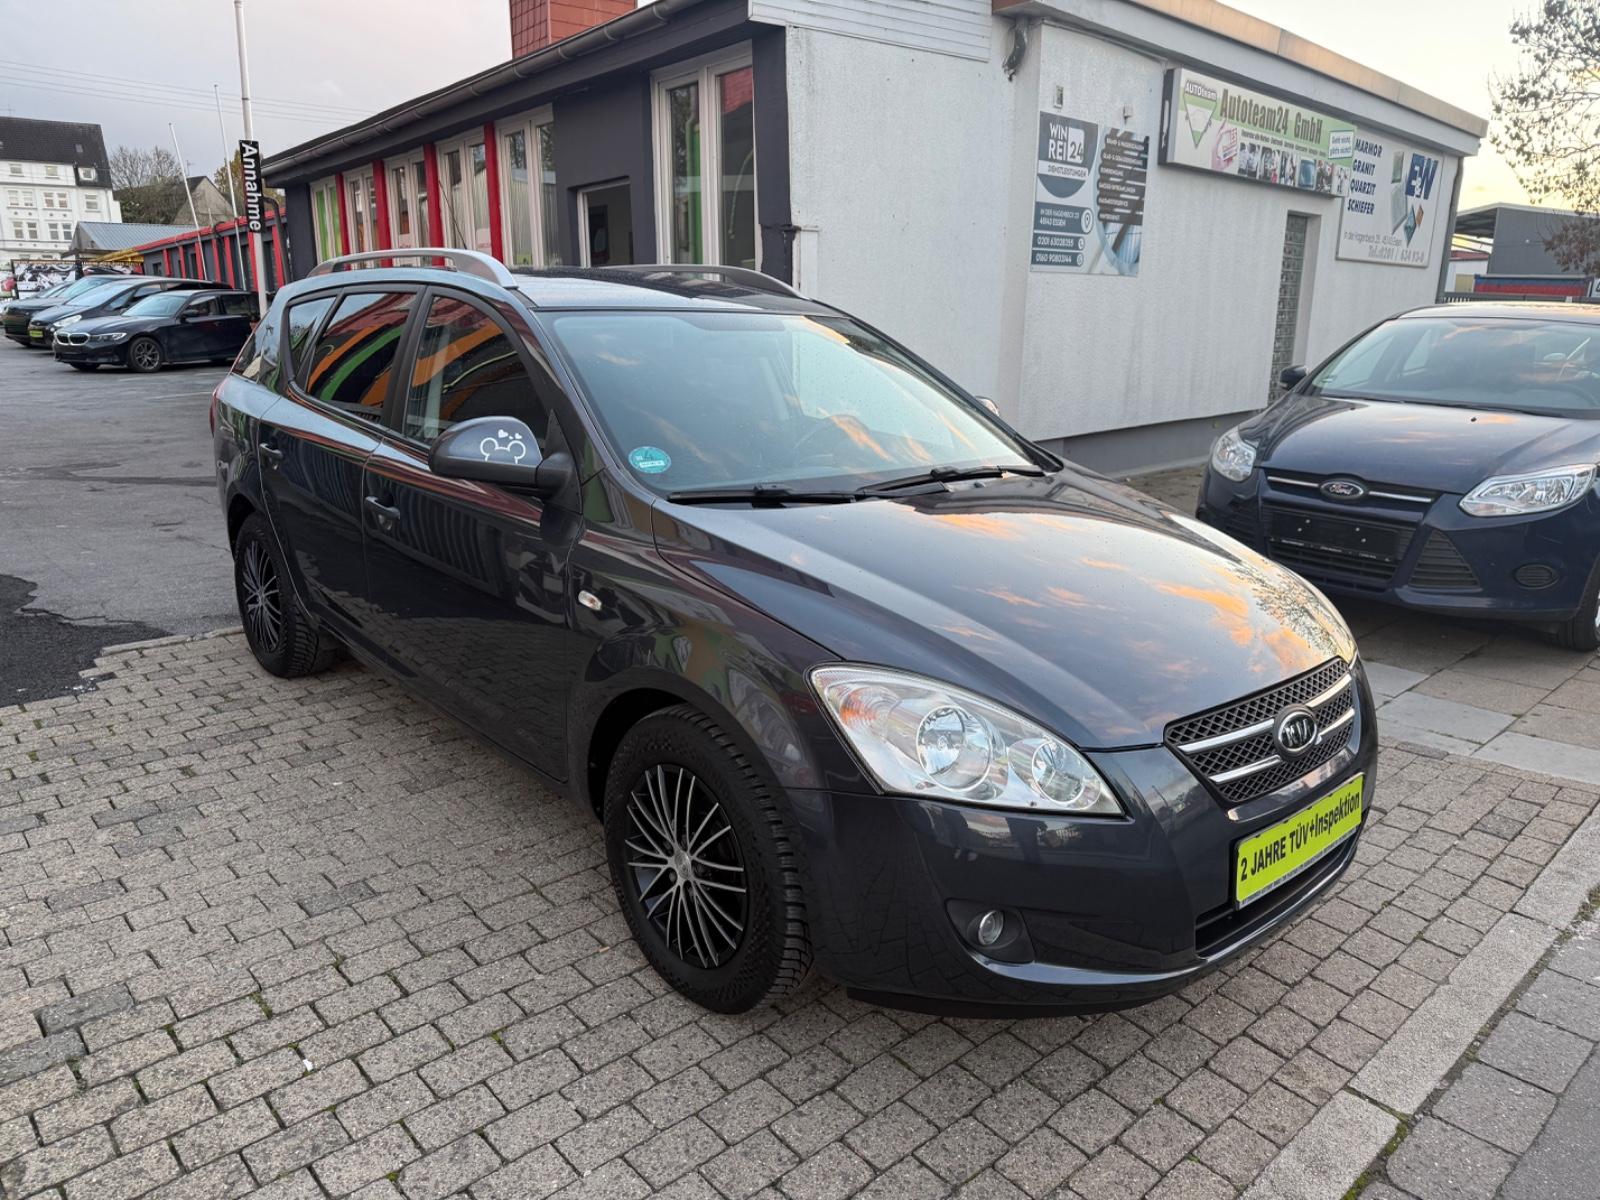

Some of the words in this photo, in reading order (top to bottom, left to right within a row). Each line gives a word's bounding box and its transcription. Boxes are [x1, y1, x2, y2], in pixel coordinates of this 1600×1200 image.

[1219, 88, 1290, 135] Autoteam24
[1293, 111, 1323, 144] GmbH
[1049, 122, 1068, 141] WIN
[1048, 139, 1067, 161] REI
[1069, 140, 1084, 161] 24
[1354, 139, 1383, 158] MARMOR
[1352, 160, 1376, 176] GRANIT
[241, 142, 262, 232] Annahme
[1349, 179, 1376, 195] QUARZIT
[1347, 198, 1375, 215] SCHIEFER
[1329, 483, 1354, 495] Ford
[1285, 718, 1314, 746] KIA
[1240, 856, 1248, 882] 2
[1250, 836, 1287, 876] JAHRE
